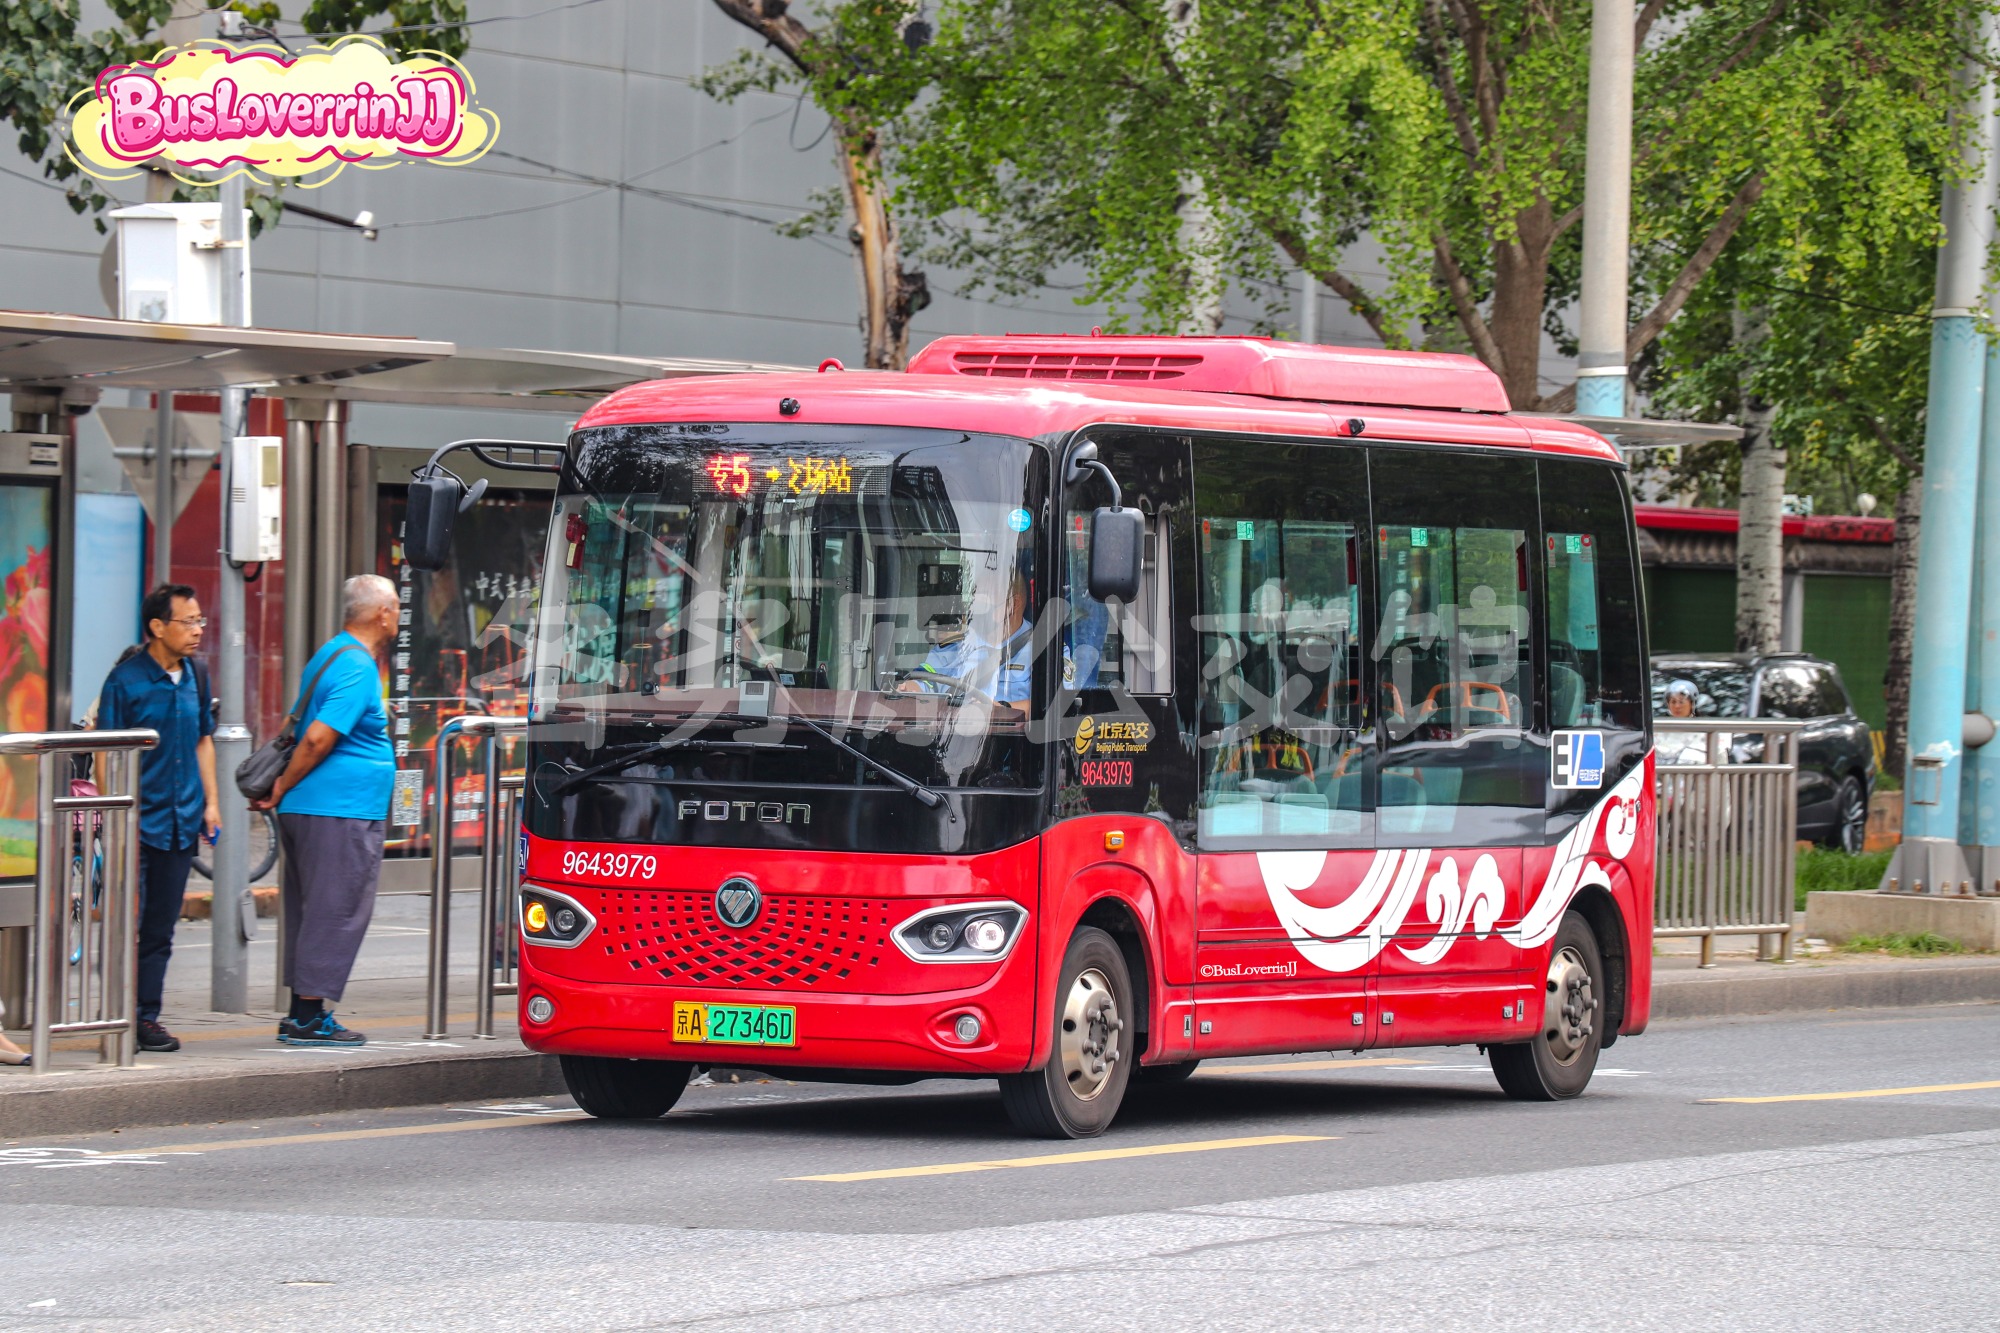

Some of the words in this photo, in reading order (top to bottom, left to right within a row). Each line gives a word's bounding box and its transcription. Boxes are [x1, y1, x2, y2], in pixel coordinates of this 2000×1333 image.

[706, 454, 751, 494] 专5
[1097, 722, 1150, 739] 北京公交
[1096, 743, 1112, 754] Beijing
[1111, 743, 1125, 752] Public
[1125, 743, 1147, 754] Transport
[1081, 761, 1132, 786] 9643979
[677, 800, 811, 824] FOTON
[562, 850, 657, 880] 9643979
